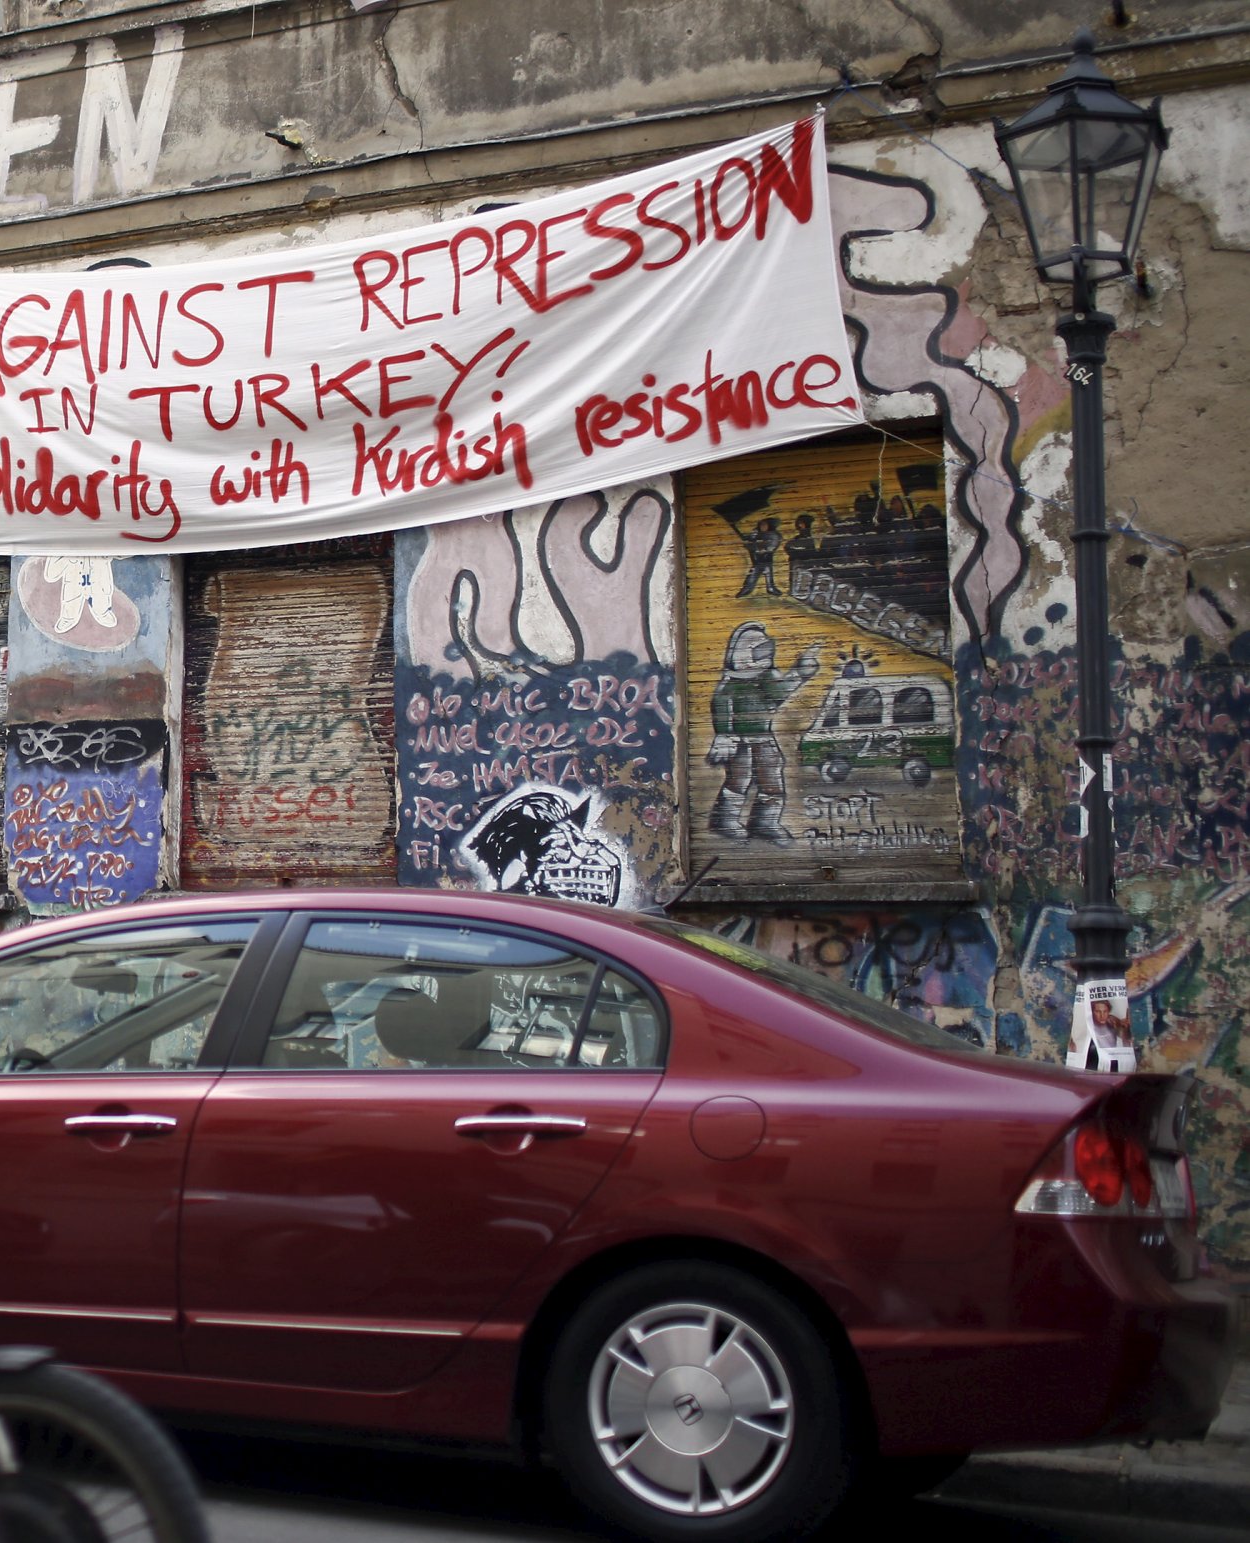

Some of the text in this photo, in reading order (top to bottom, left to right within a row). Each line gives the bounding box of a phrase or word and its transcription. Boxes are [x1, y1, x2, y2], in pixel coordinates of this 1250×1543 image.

[353, 116, 820, 331] REPRESSION
[19, 328, 531, 442] IN TURKEY!
[210, 438, 310, 504] with
[352, 411, 534, 497] Kurdish
[575, 349, 856, 458] resistance
[1066, 362, 1094, 386] 164
[1089, 986, 1107, 994] WER
